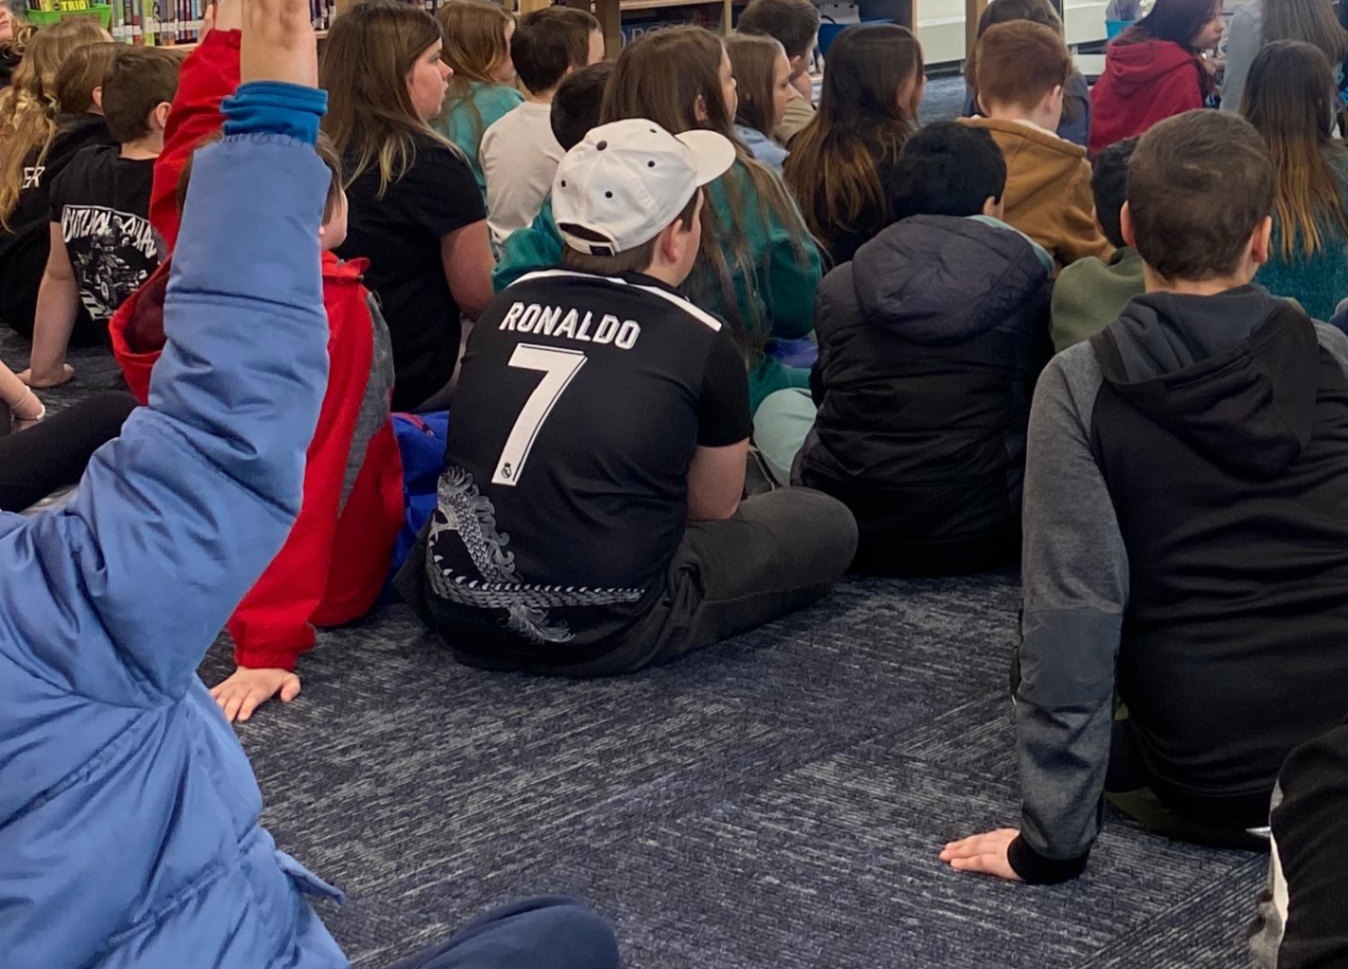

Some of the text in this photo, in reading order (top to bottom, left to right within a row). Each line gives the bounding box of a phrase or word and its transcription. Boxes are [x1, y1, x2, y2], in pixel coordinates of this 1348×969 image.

[61, 0, 86, 11] TRIO
[499, 301, 641, 350] RONALDO
[491, 342, 588, 487] 7
